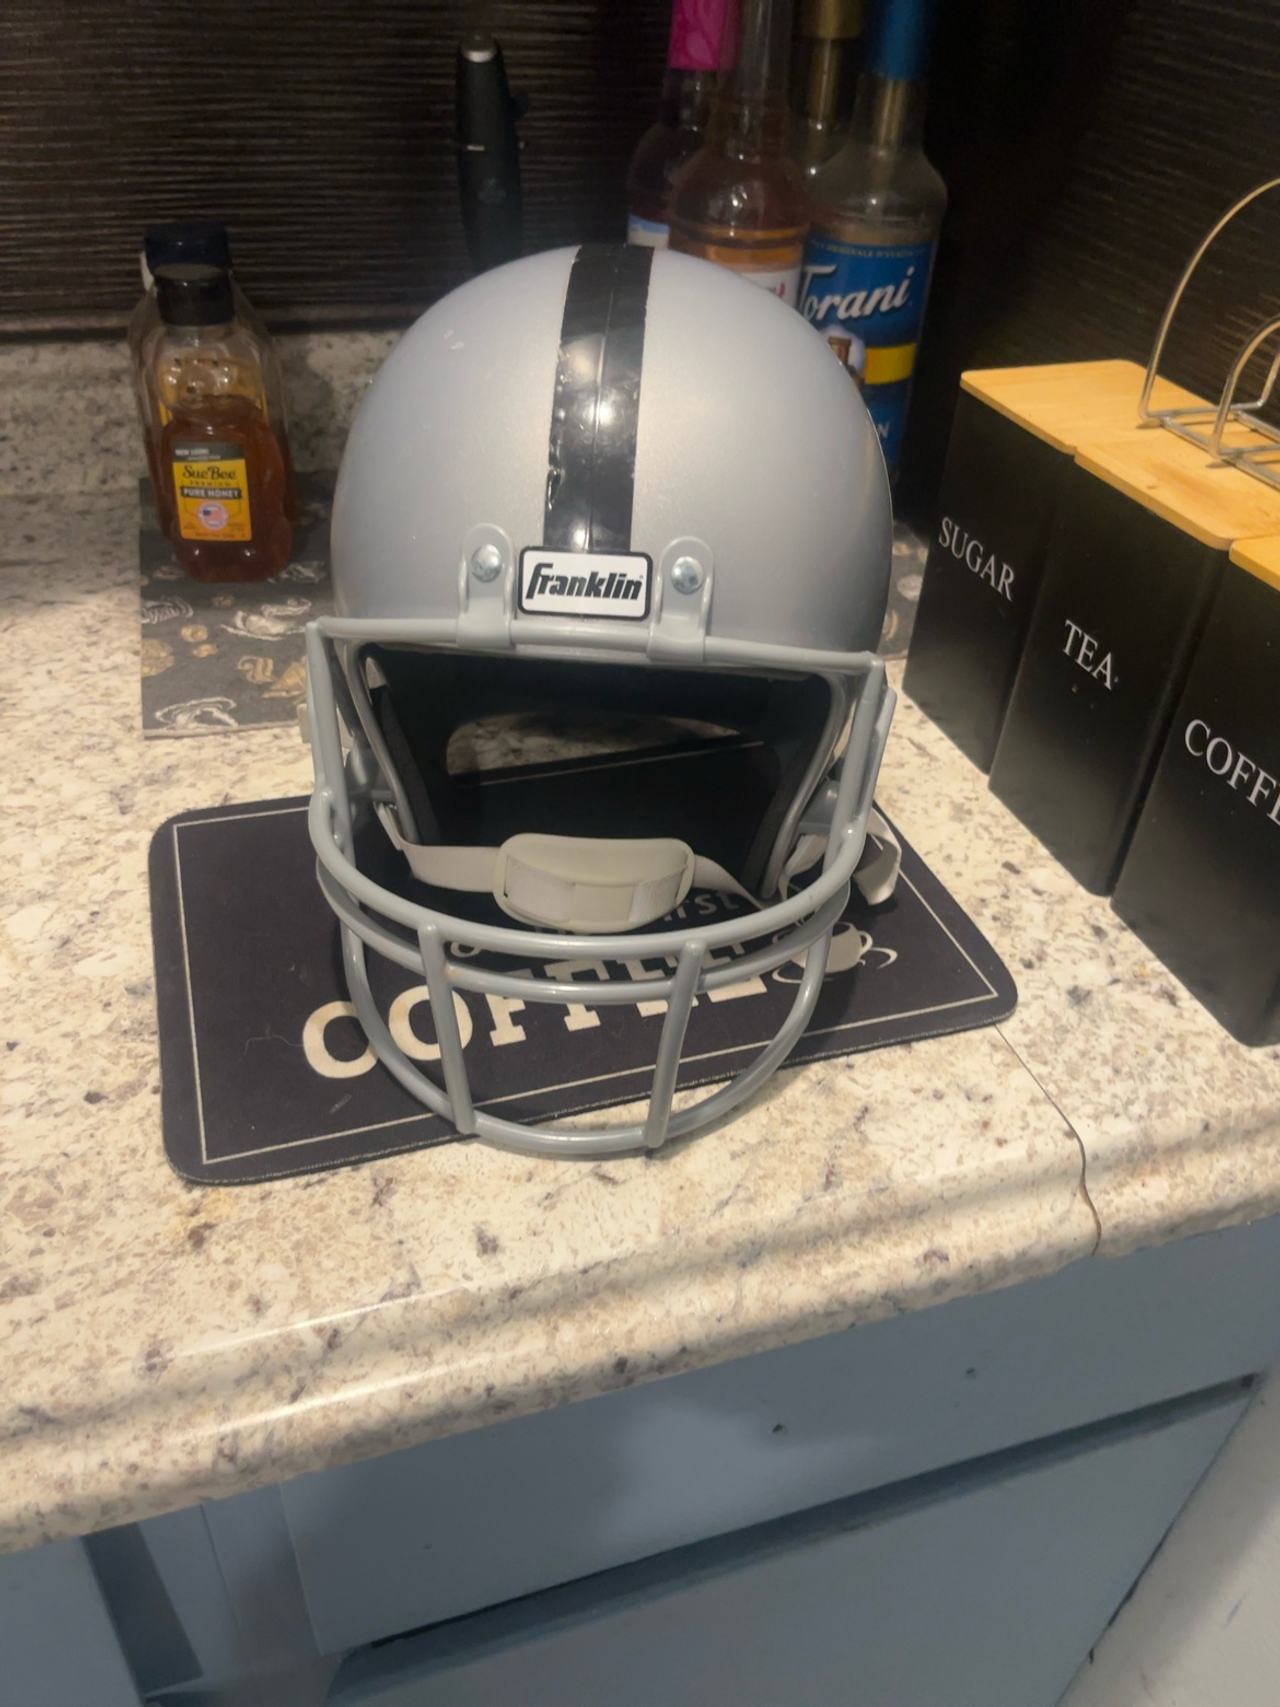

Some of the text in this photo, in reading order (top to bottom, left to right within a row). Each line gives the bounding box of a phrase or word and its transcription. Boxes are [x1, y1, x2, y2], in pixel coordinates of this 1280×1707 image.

[800, 263, 915, 321] Torani
[183, 487, 239, 499] PURE HONEY
[525, 562, 642, 600] Franklin
[938, 516, 1016, 602] SUGAR
[1063, 619, 1115, 690] TEA
